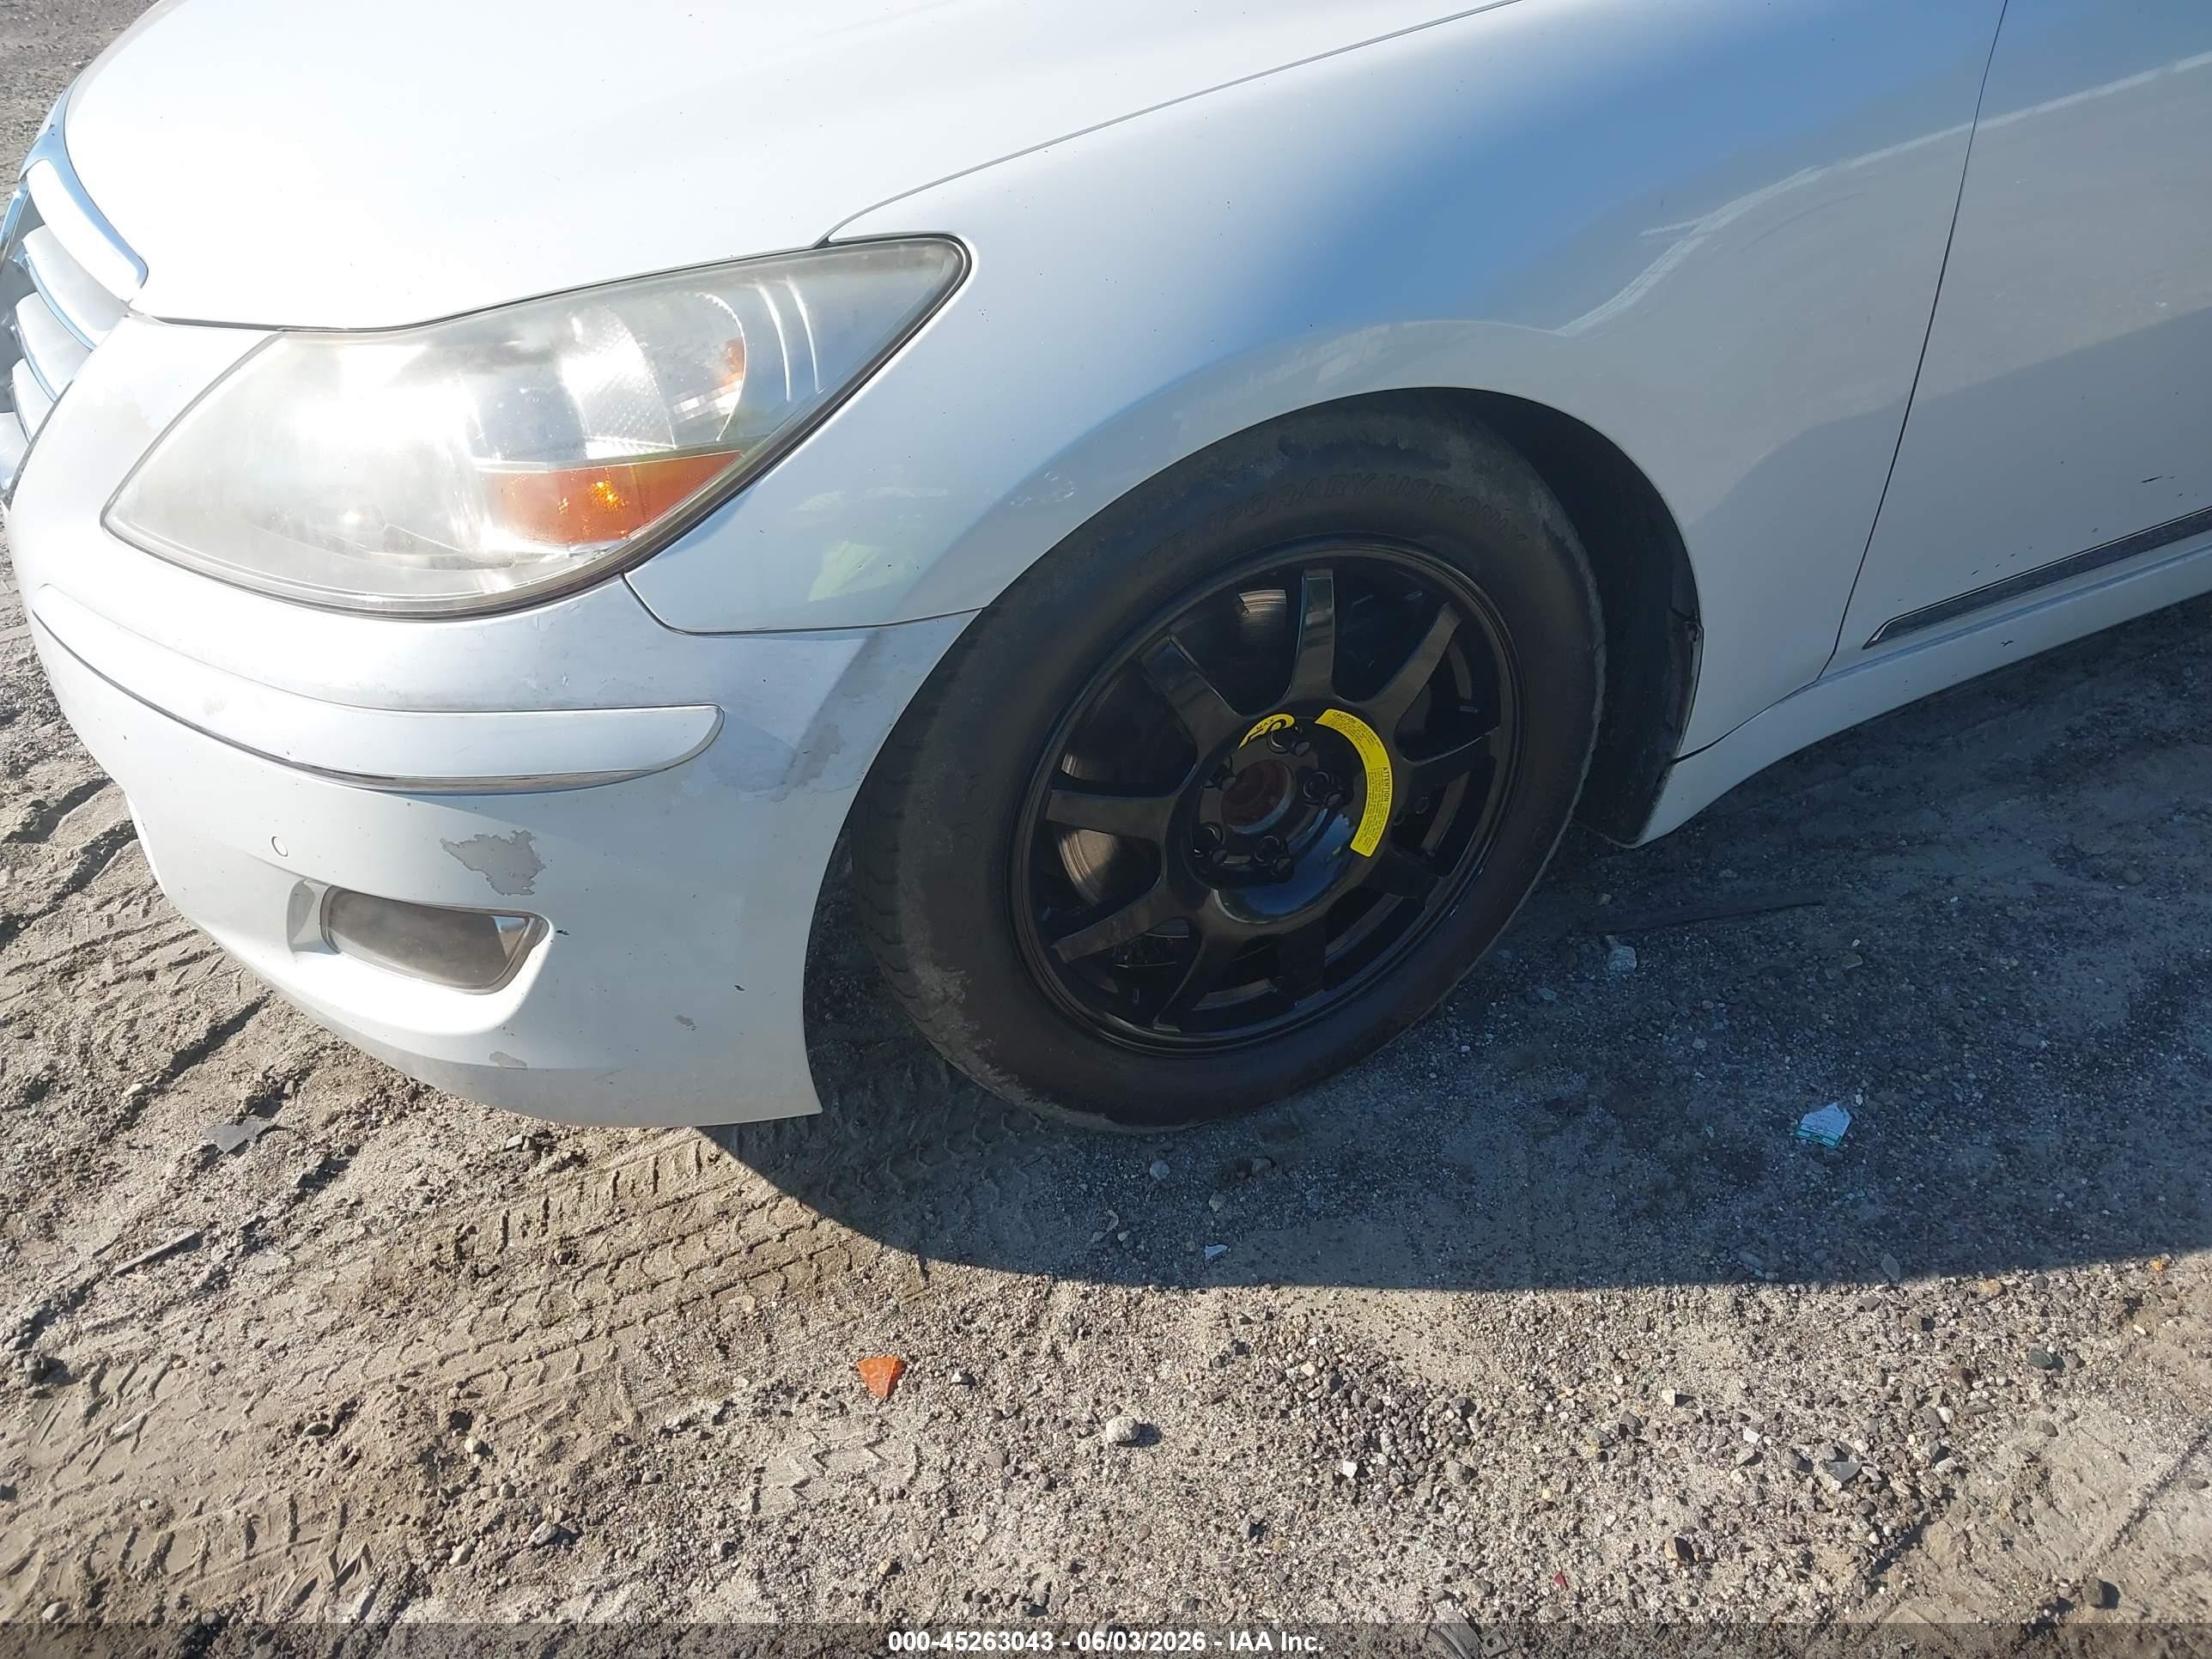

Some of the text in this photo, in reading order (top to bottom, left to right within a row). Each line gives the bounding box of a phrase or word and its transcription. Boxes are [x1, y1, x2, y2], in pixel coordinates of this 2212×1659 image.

[1256, 718, 1274, 730] MAX
[1333, 712, 1358, 725] CAUTION
[1382, 767, 1391, 802] ATTENTION
